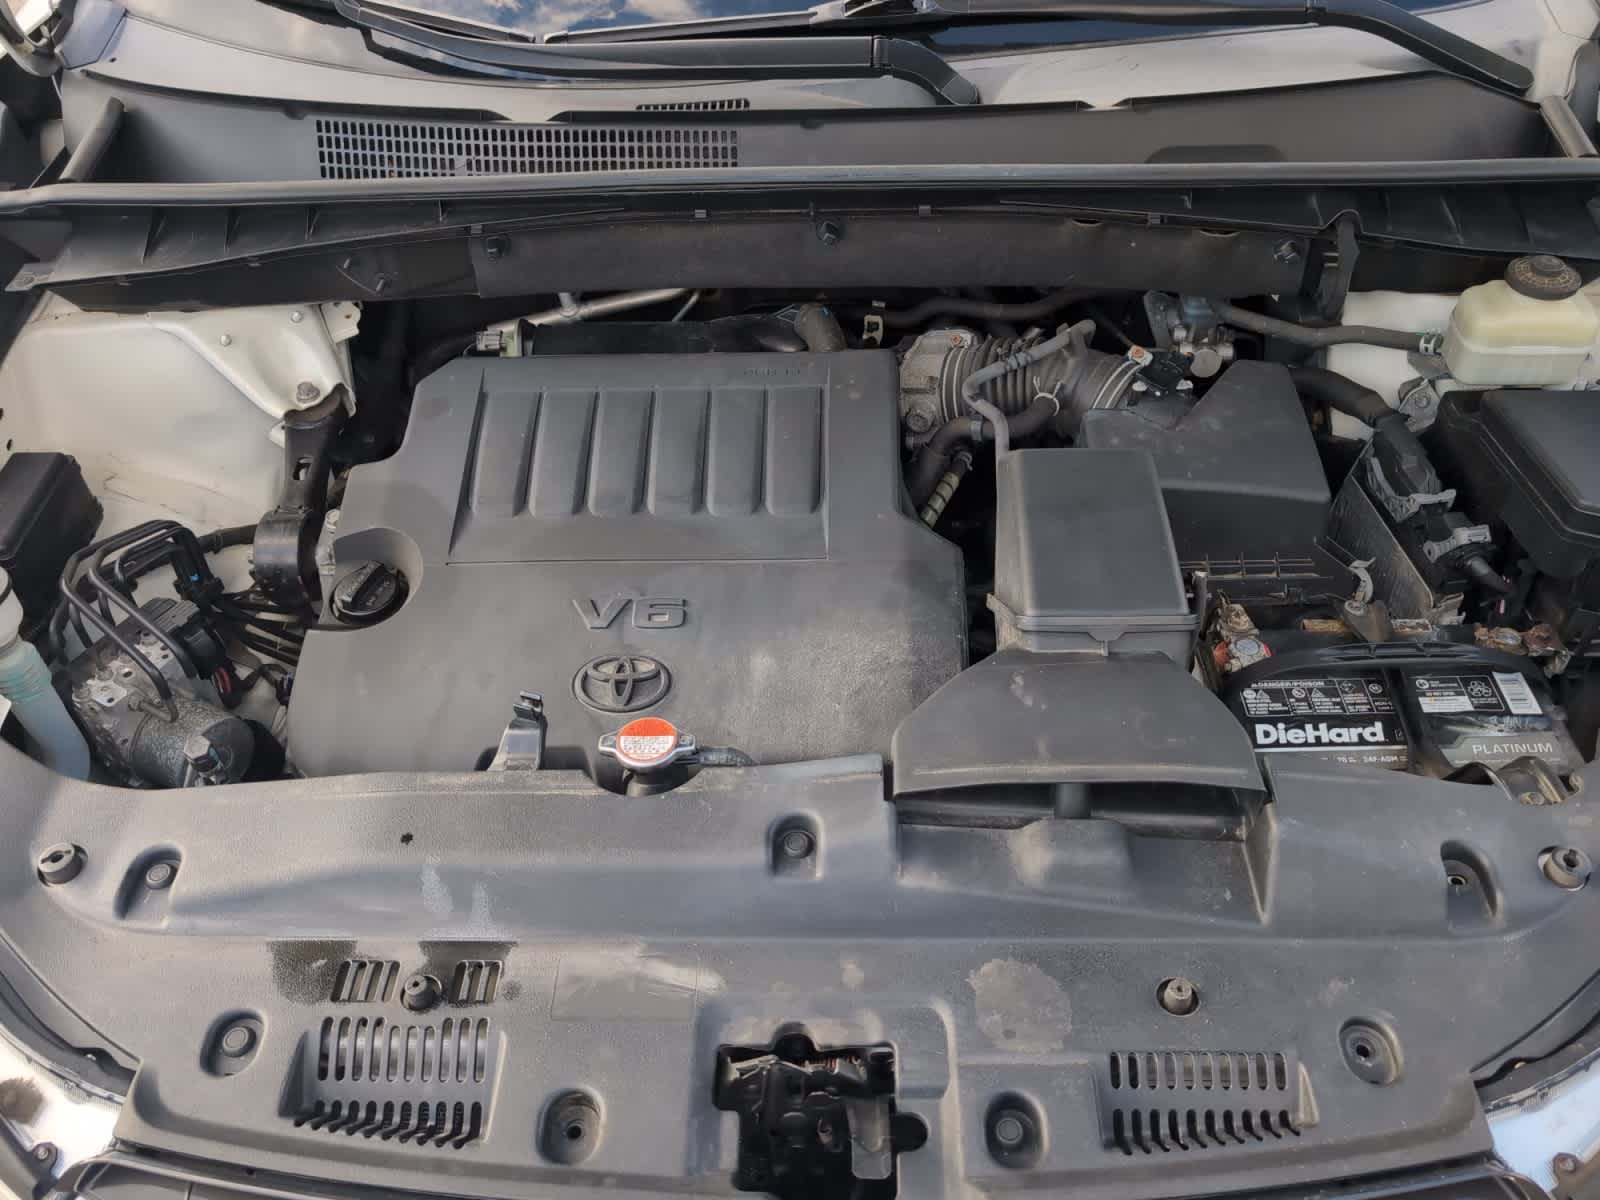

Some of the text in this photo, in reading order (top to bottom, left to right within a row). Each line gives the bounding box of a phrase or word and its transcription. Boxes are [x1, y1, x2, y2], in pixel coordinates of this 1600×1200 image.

[572, 595, 688, 629] V6
[1255, 721, 1385, 744] DieHard
[1472, 742, 1553, 755] PLATINUM
